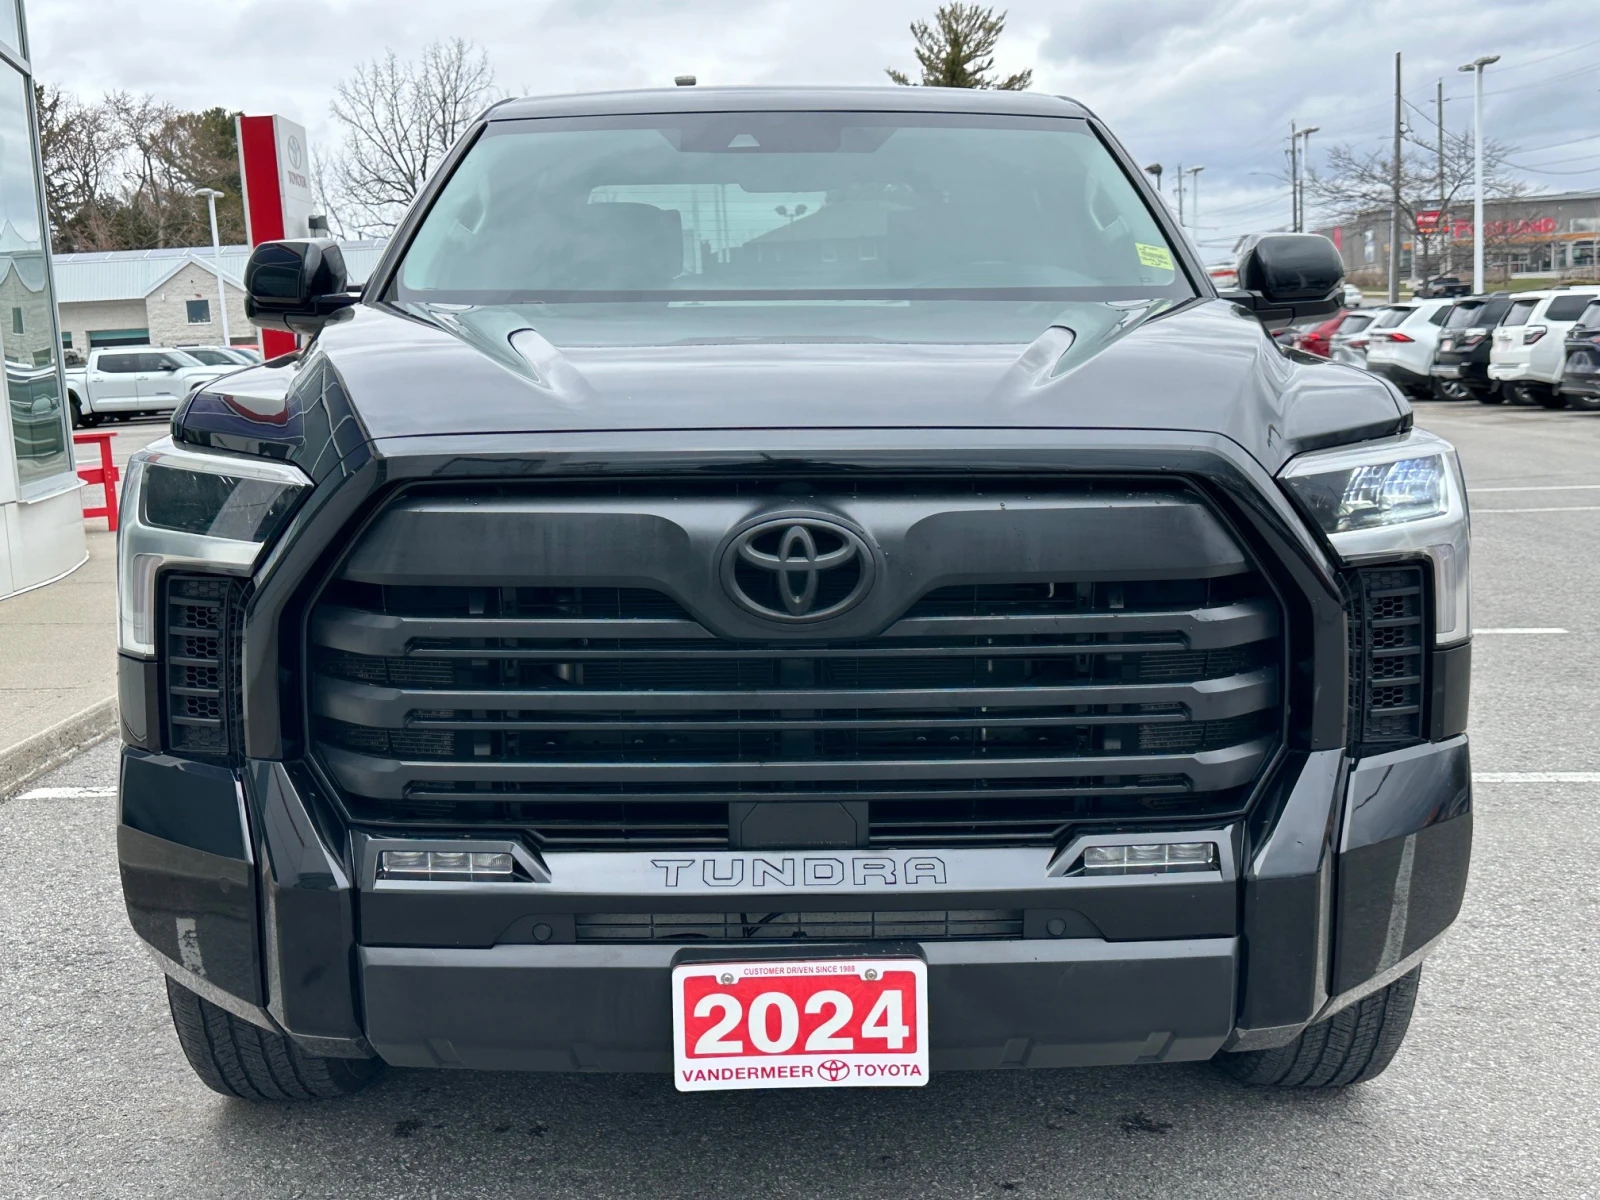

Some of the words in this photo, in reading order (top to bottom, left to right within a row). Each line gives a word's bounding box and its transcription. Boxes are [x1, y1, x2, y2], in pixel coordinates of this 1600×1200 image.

[287, 170, 308, 189] TOYOTA
[650, 857, 948, 888] TUNDRA
[743, 967, 785, 975] CUSTOMER
[786, 965, 814, 974] DRIVEN
[815, 965, 838, 973] SINCE
[693, 989, 910, 1055] 2024
[682, 1065, 814, 1082] VANDERMEER
[853, 1063, 922, 1077] TOYOTA
